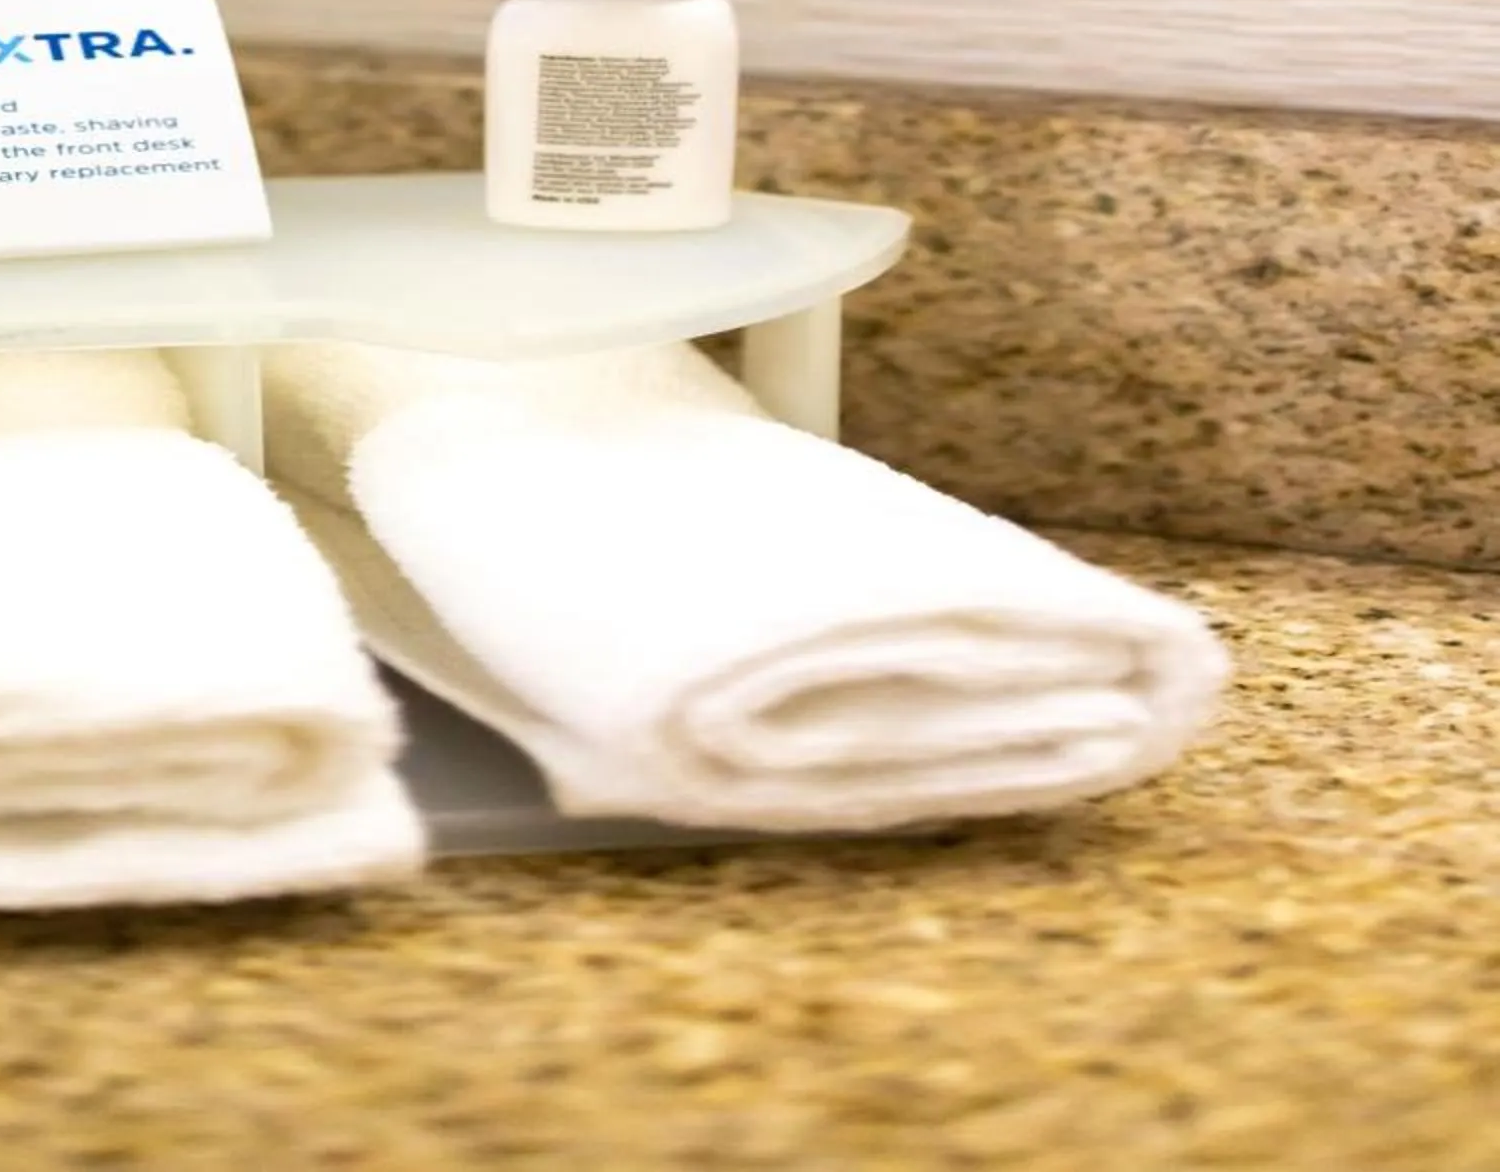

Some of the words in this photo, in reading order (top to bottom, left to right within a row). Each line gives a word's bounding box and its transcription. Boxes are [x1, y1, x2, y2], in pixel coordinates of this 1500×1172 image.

[74, 116, 178, 133] shaving
[1, 144, 46, 159] the
[56, 142, 122, 157] front
[133, 137, 194, 153] desk
[50, 159, 220, 180] replacement
